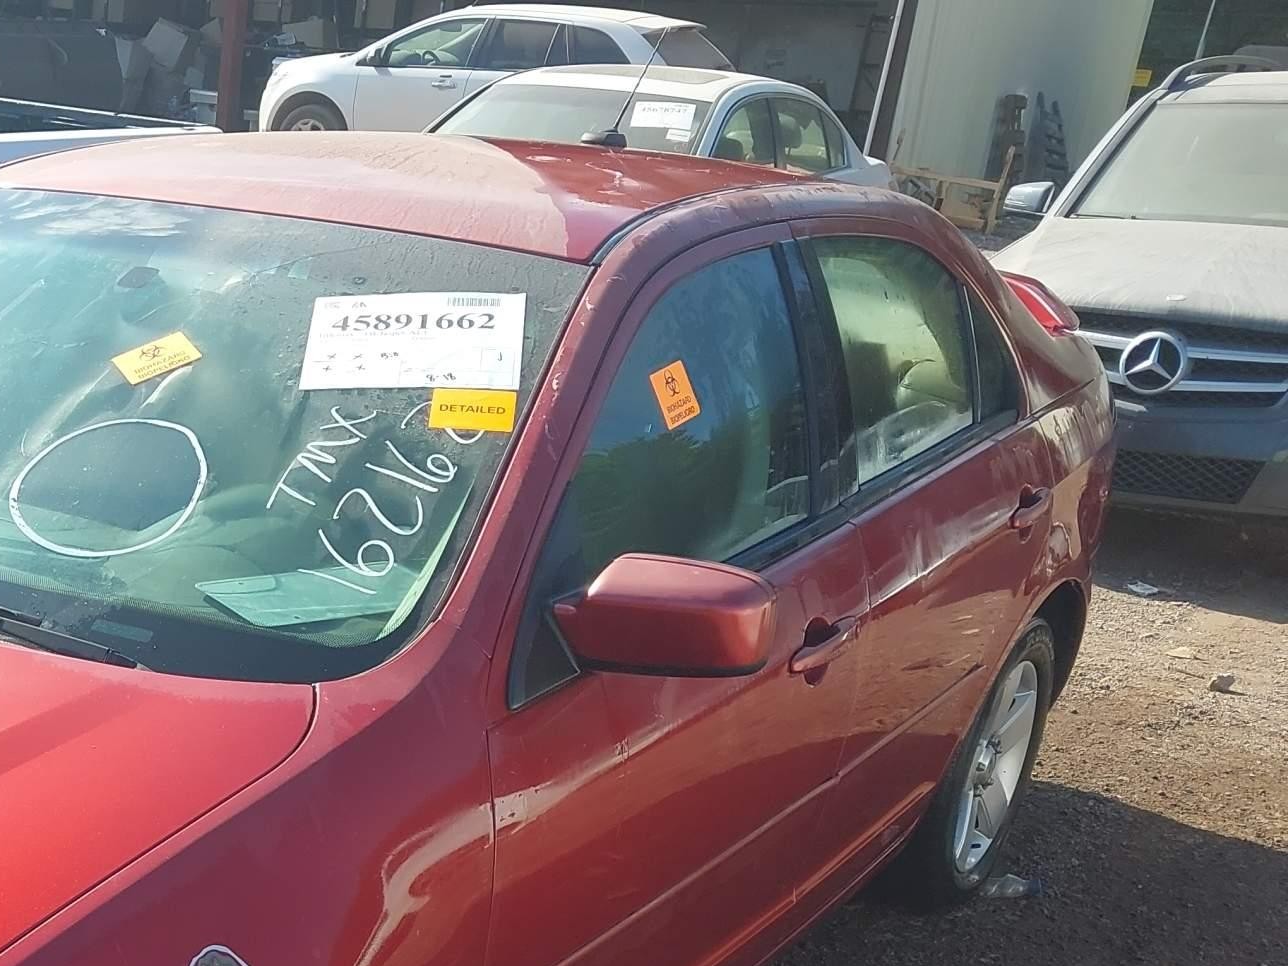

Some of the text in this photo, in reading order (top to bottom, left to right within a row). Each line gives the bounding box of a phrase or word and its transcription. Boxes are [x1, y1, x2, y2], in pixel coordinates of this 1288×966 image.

[331, 313, 496, 331] 45891662
[439, 403, 506, 415] DETAILED
[265, 404, 378, 510] TMX
